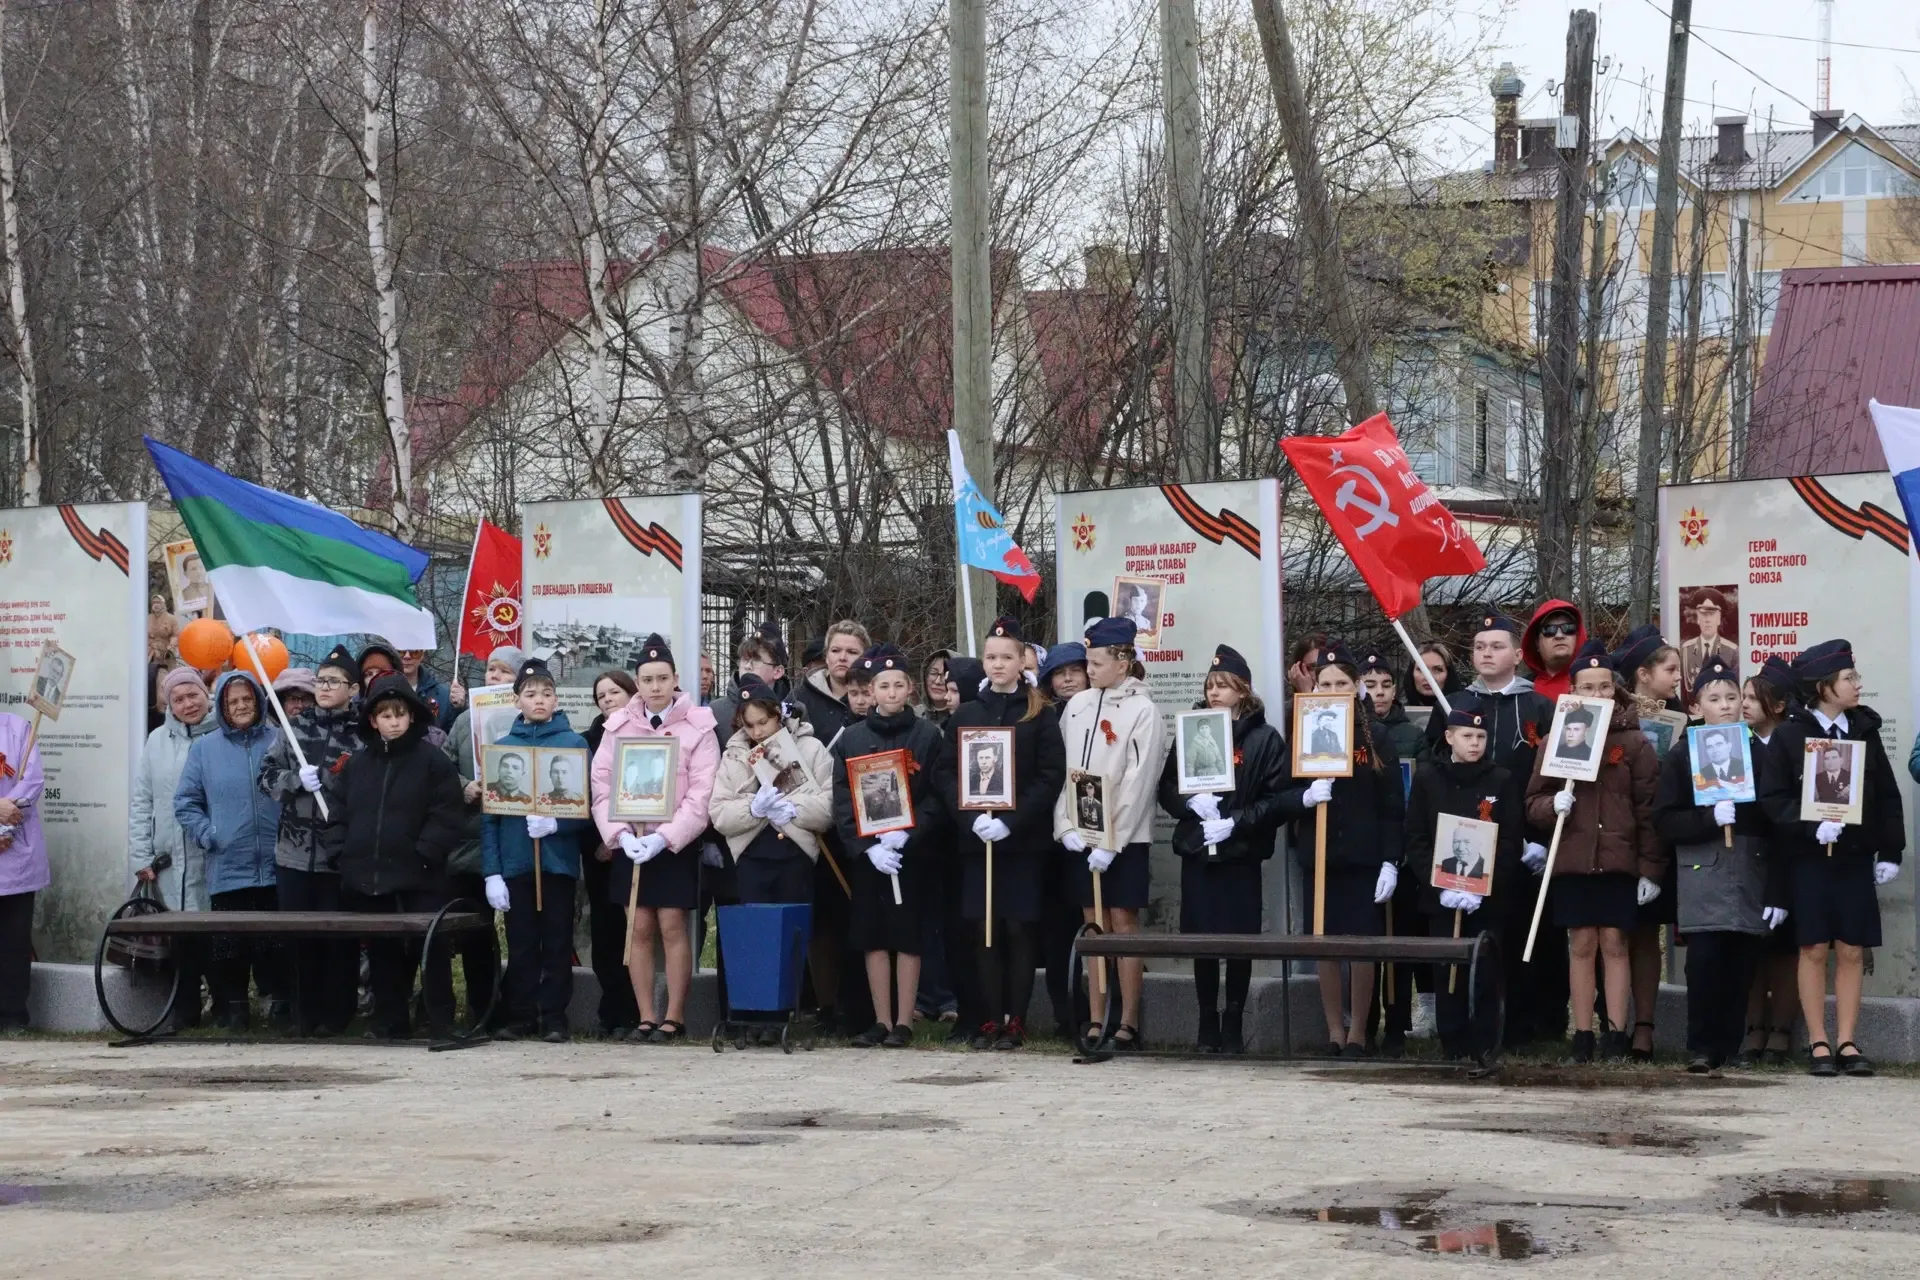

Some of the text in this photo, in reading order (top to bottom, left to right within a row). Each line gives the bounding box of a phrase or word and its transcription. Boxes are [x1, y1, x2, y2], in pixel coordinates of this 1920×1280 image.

[1125, 542, 1197, 557] ПОЛНЫЙ КАВАЛЕР
[1749, 539, 1777, 552] ГЕРОЙ
[1125, 558, 1186, 573] ОРДЕНА СЛАВЫ
[1749, 554, 1807, 568] СОВЕТСКОГО
[1749, 571, 1782, 584] СОЮЗА
[532, 583, 613, 596] СТО ДВЕНАДЦАТЬ УЛЯШЕВЫХ
[1750, 612, 1808, 628] ТИМУШЕВ
[1750, 630, 1797, 648] Георгий
[45, 788, 60, 800] 3645
